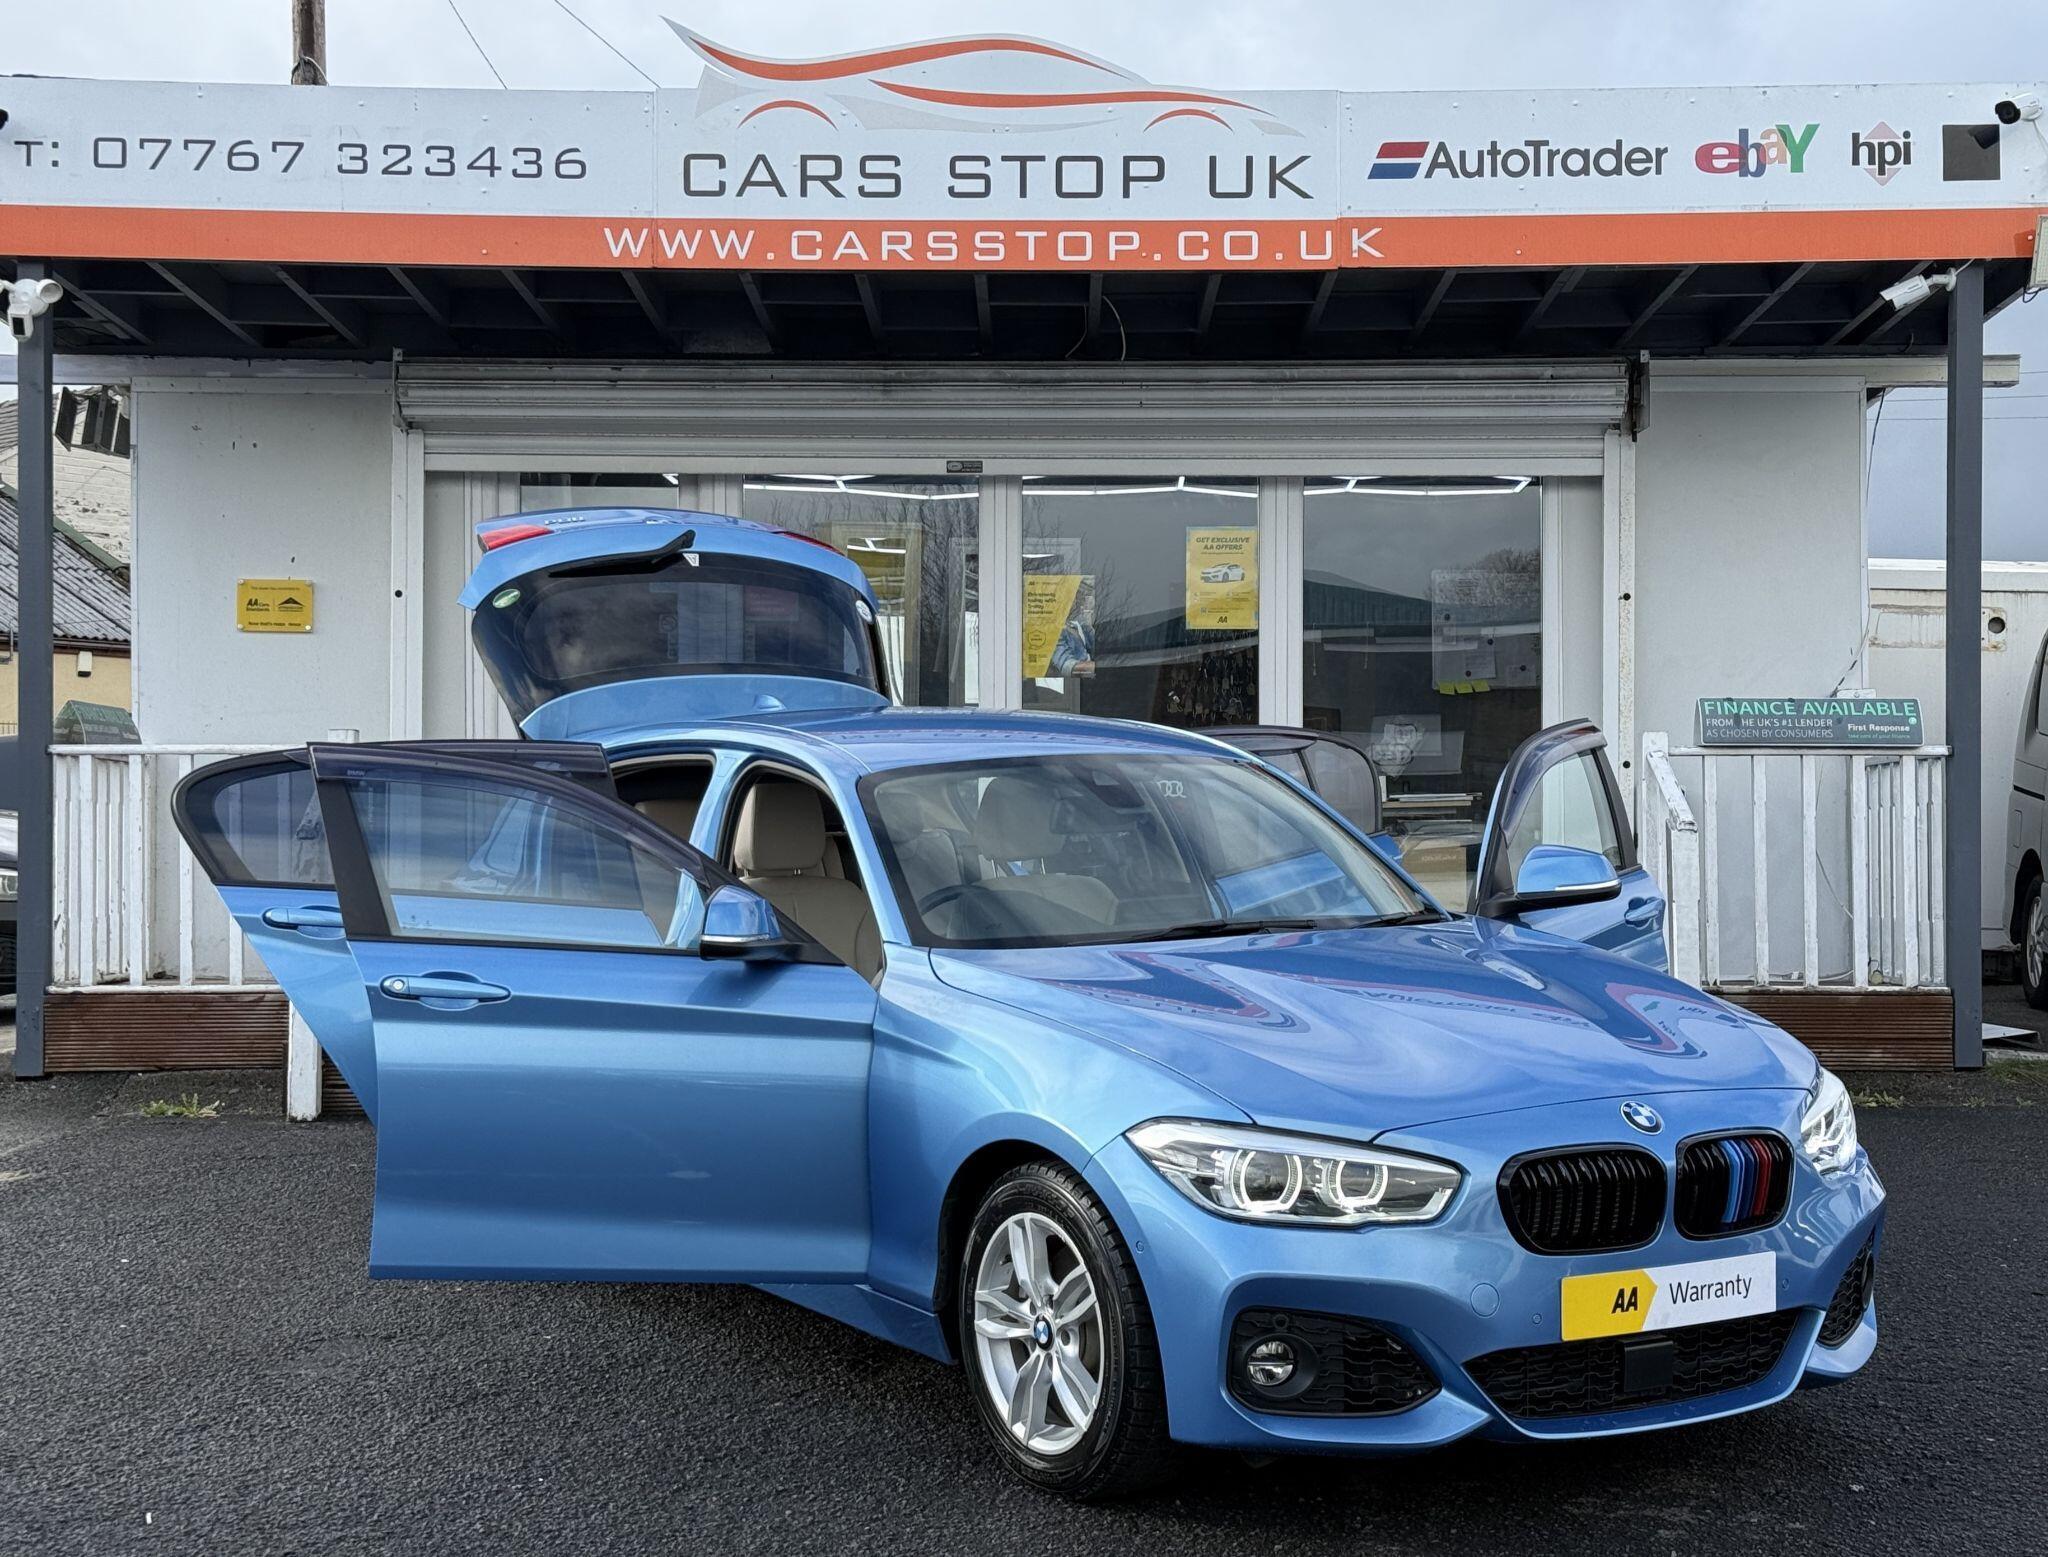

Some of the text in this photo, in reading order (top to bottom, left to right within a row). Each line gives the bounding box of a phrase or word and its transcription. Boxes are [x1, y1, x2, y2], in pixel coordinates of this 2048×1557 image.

[14, 137, 588, 180] T: 07767 323436
[1423, 139, 1669, 179] AutoTrader
[1851, 130, 1912, 176] hpi
[683, 153, 1314, 200] CARS STOP UK
[603, 226, 1384, 262] WWW.CARSSTOP.CO.UK
[246, 598, 259, 607] AA
[1704, 701, 1917, 717] FINANCE AVAILABLE
[1706, 718, 1734, 728] FROM
[1757, 718, 1780, 728] UK'S
[1782, 718, 1793, 728] #1
[1795, 718, 1833, 728] LENDER
[1706, 729, 1834, 739] AS CHOSEN BY CONSUMERS
[1847, 723, 1910, 734] First Response
[1611, 1273, 1752, 1314] AA Warranty
